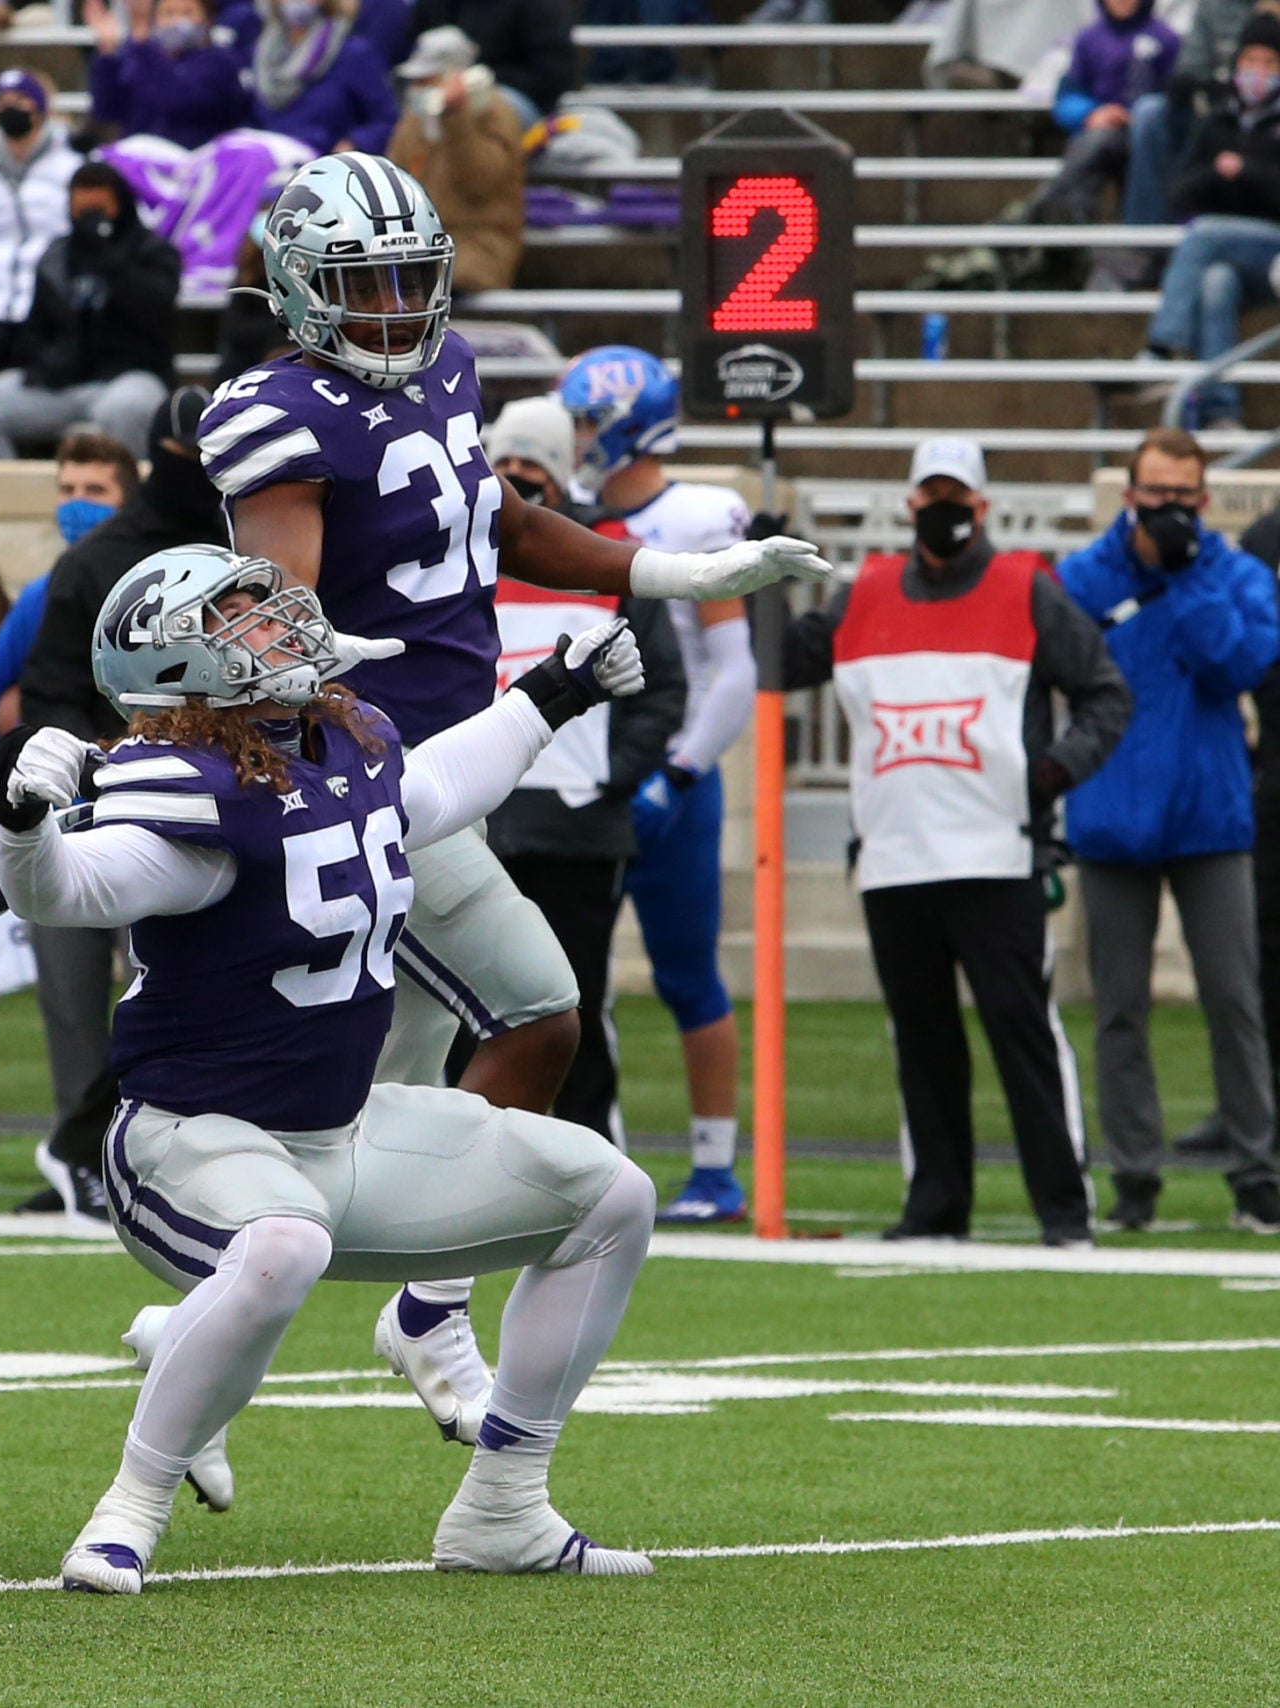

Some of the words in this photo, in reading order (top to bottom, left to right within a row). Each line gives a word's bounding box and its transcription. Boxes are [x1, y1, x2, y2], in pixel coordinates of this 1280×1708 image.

[381, 236, 420, 248] K-STATE
[712, 177, 818, 331] 2
[312, 378, 350, 406] C
[586, 360, 645, 402] KU
[377, 411, 503, 604] 32
[871, 695, 986, 778] XII
[271, 805, 415, 1007] 56
